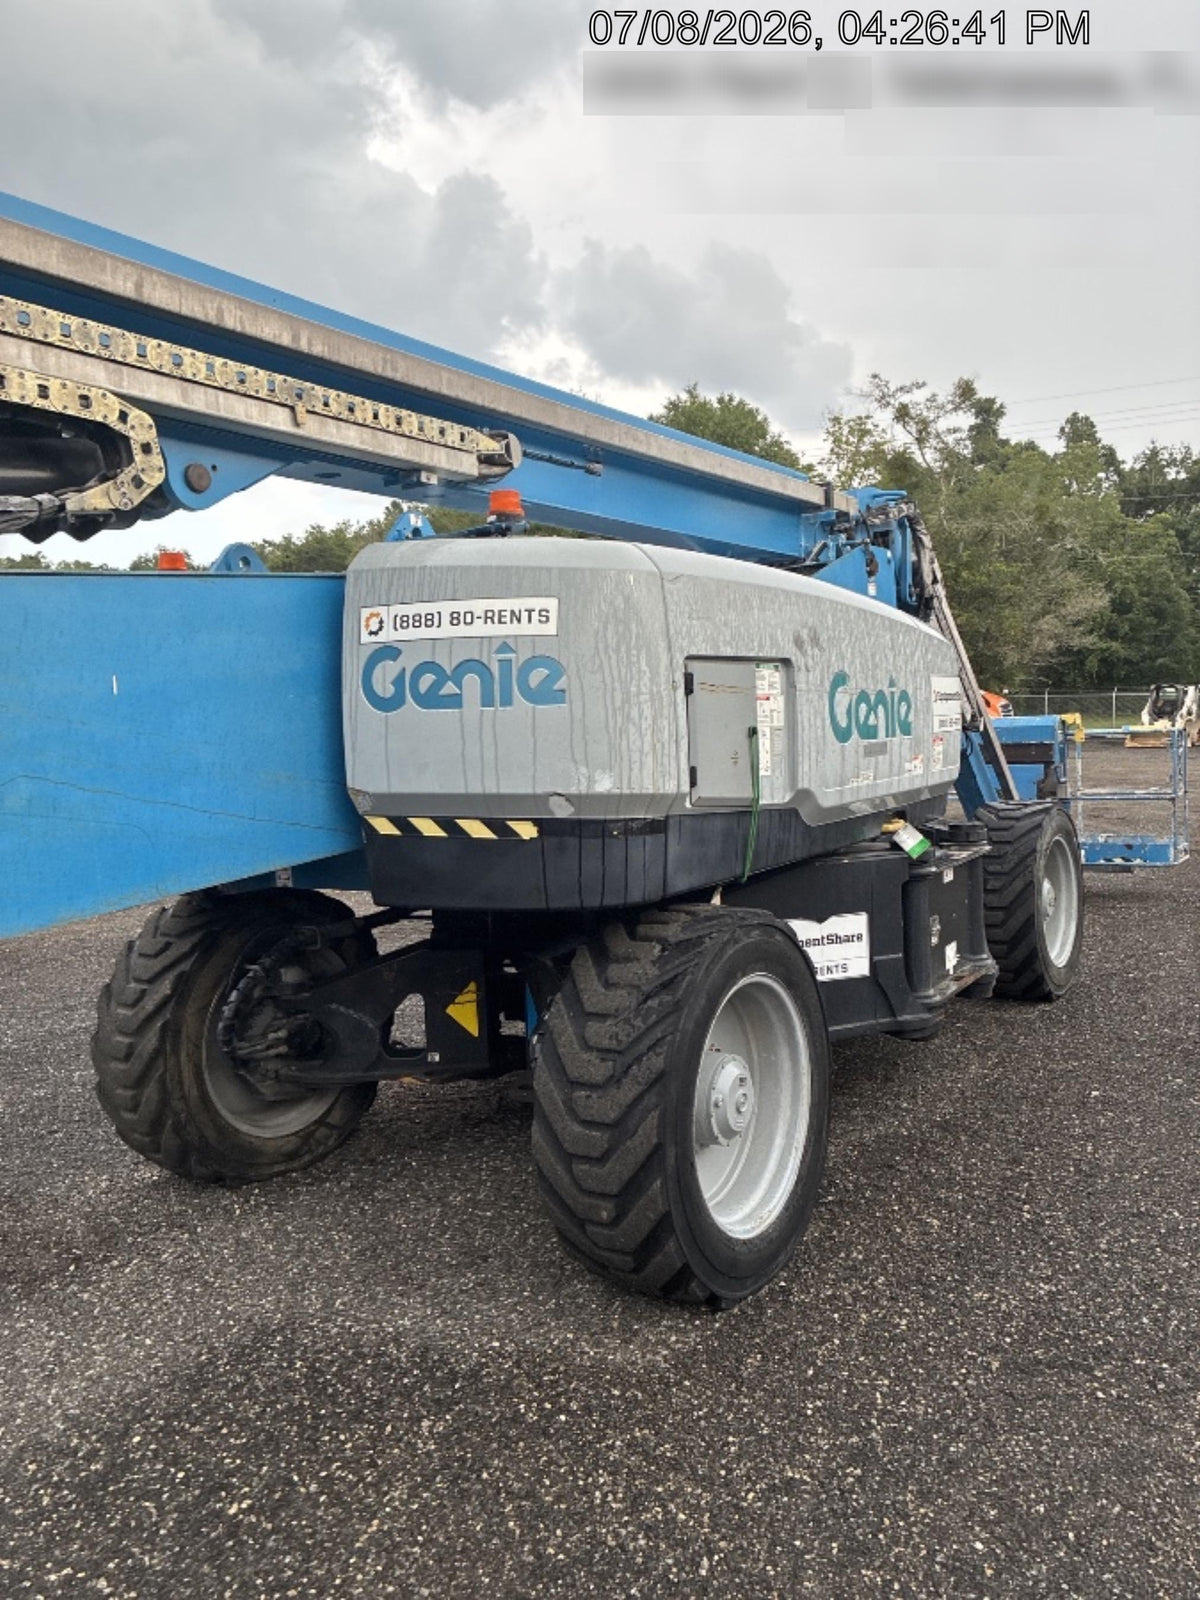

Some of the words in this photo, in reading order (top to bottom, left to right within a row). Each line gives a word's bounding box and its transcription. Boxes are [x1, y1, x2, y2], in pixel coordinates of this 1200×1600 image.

[393, 611, 442, 631] (888)
[449, 608, 550, 626] 80-RENTS
[361, 641, 567, 713] Genie
[828, 670, 912, 745] Genie
